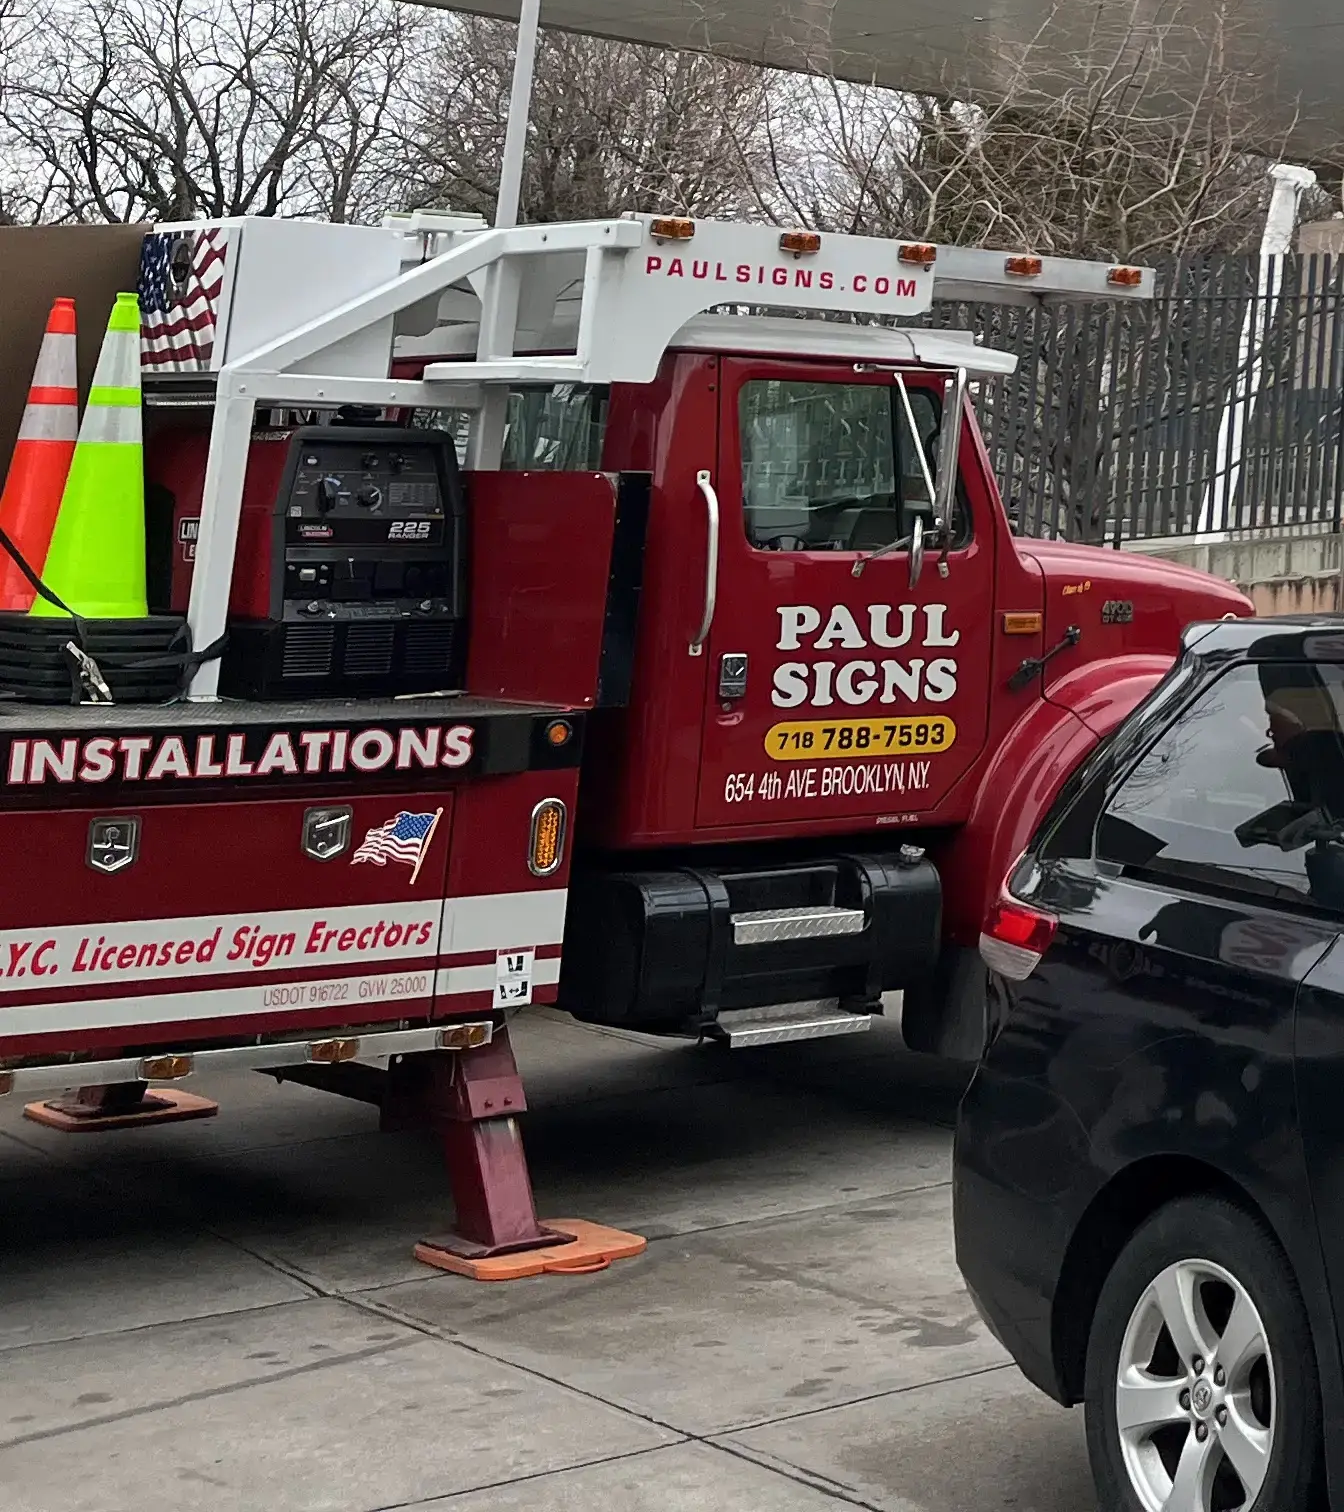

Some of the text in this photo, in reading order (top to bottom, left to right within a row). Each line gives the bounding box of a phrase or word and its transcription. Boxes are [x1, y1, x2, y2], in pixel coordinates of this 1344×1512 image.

[645, 255, 917, 298] PAULSIGNS.COM
[387, 532, 430, 540] RANGER
[389, 521, 432, 533] 225
[775, 604, 960, 650] PAUL
[771, 658, 957, 708] SIGNS
[7, 725, 476, 785] INSTALLATIONS
[777, 723, 945, 750] 718 788-7593
[724, 773, 755, 803] 654
[757, 770, 782, 801] 4th
[820, 762, 905, 795] BROOKLYN,
[0, 920, 434, 978] .Y.C. Licensed Sign Erectors
[263, 986, 308, 1007] USDOT
[357, 979, 389, 999] GVW
